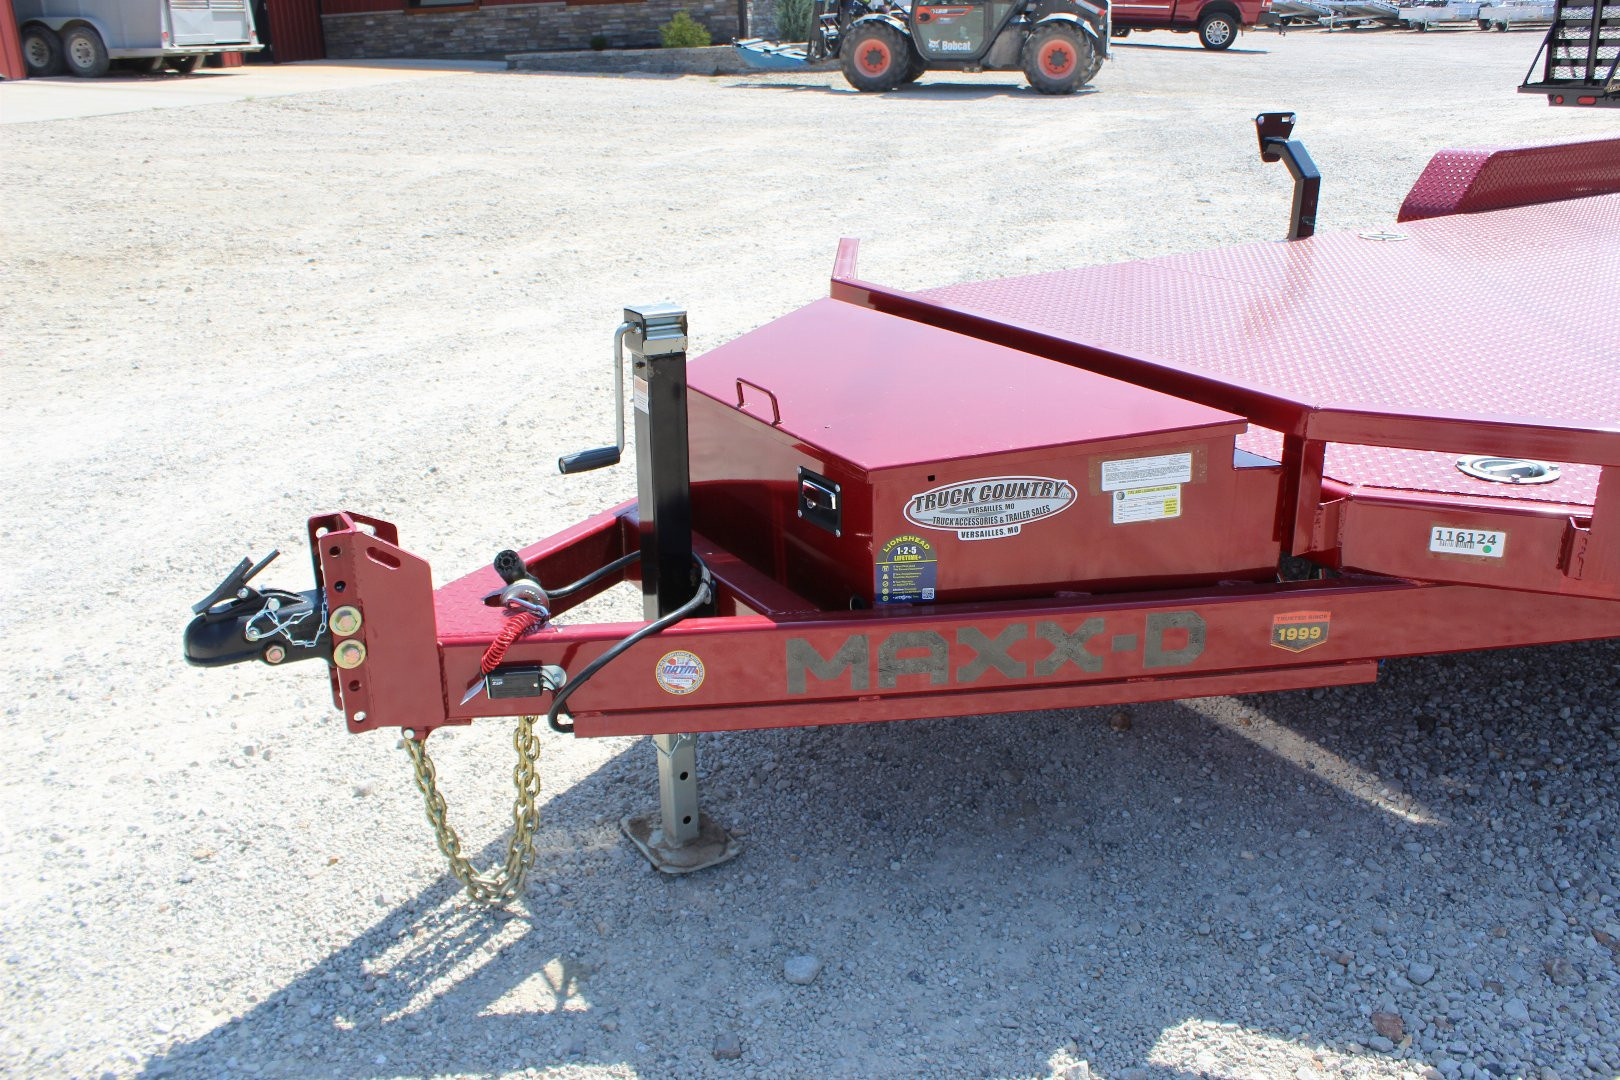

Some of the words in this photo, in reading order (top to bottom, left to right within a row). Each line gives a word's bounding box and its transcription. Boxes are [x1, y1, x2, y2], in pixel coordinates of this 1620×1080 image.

[941, 40, 971, 51] Bobcat
[914, 487, 976, 513] TRUCK
[979, 481, 1065, 504] COUNTRY
[932, 516, 955, 526] TRUCK
[954, 515, 998, 526] ACCESSORIES
[999, 514, 1005, 524] &
[1005, 509, 1031, 522] TRAILER
[1031, 504, 1051, 516] SALES
[1007, 525, 1019, 534] MO
[1435, 530, 1497, 546] 116124
[882, 535, 930, 553] LIONSHEAD
[1278, 626, 1321, 641] 1999
[786, 611, 1207, 695] MAXX-D
